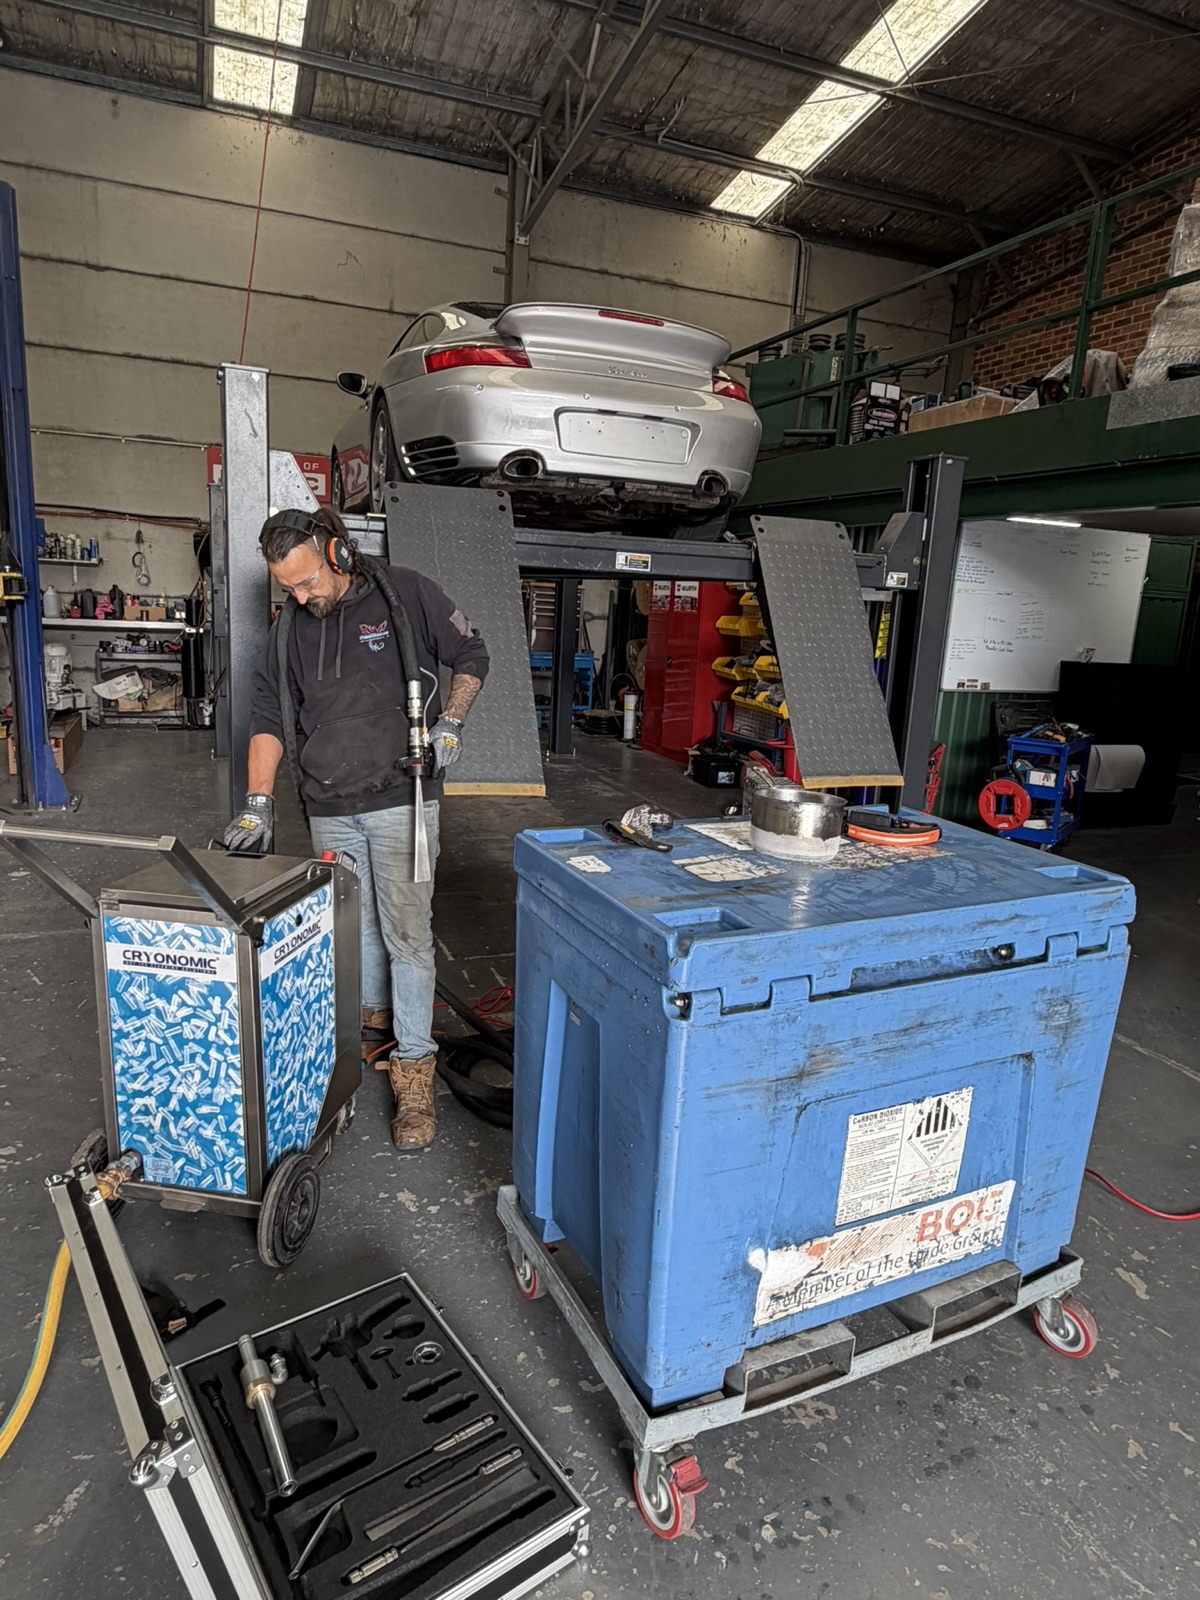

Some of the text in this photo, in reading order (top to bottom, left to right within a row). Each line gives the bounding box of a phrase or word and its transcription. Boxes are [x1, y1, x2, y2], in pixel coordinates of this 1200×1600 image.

[303, 462, 320, 470] OF
[274, 920, 322, 960] CRYONOMIC
[122, 949, 217, 968] CRYONOMIC
[852, 1106, 903, 1125] CARBON DIOXIDE
[876, 1252, 904, 1276] the
